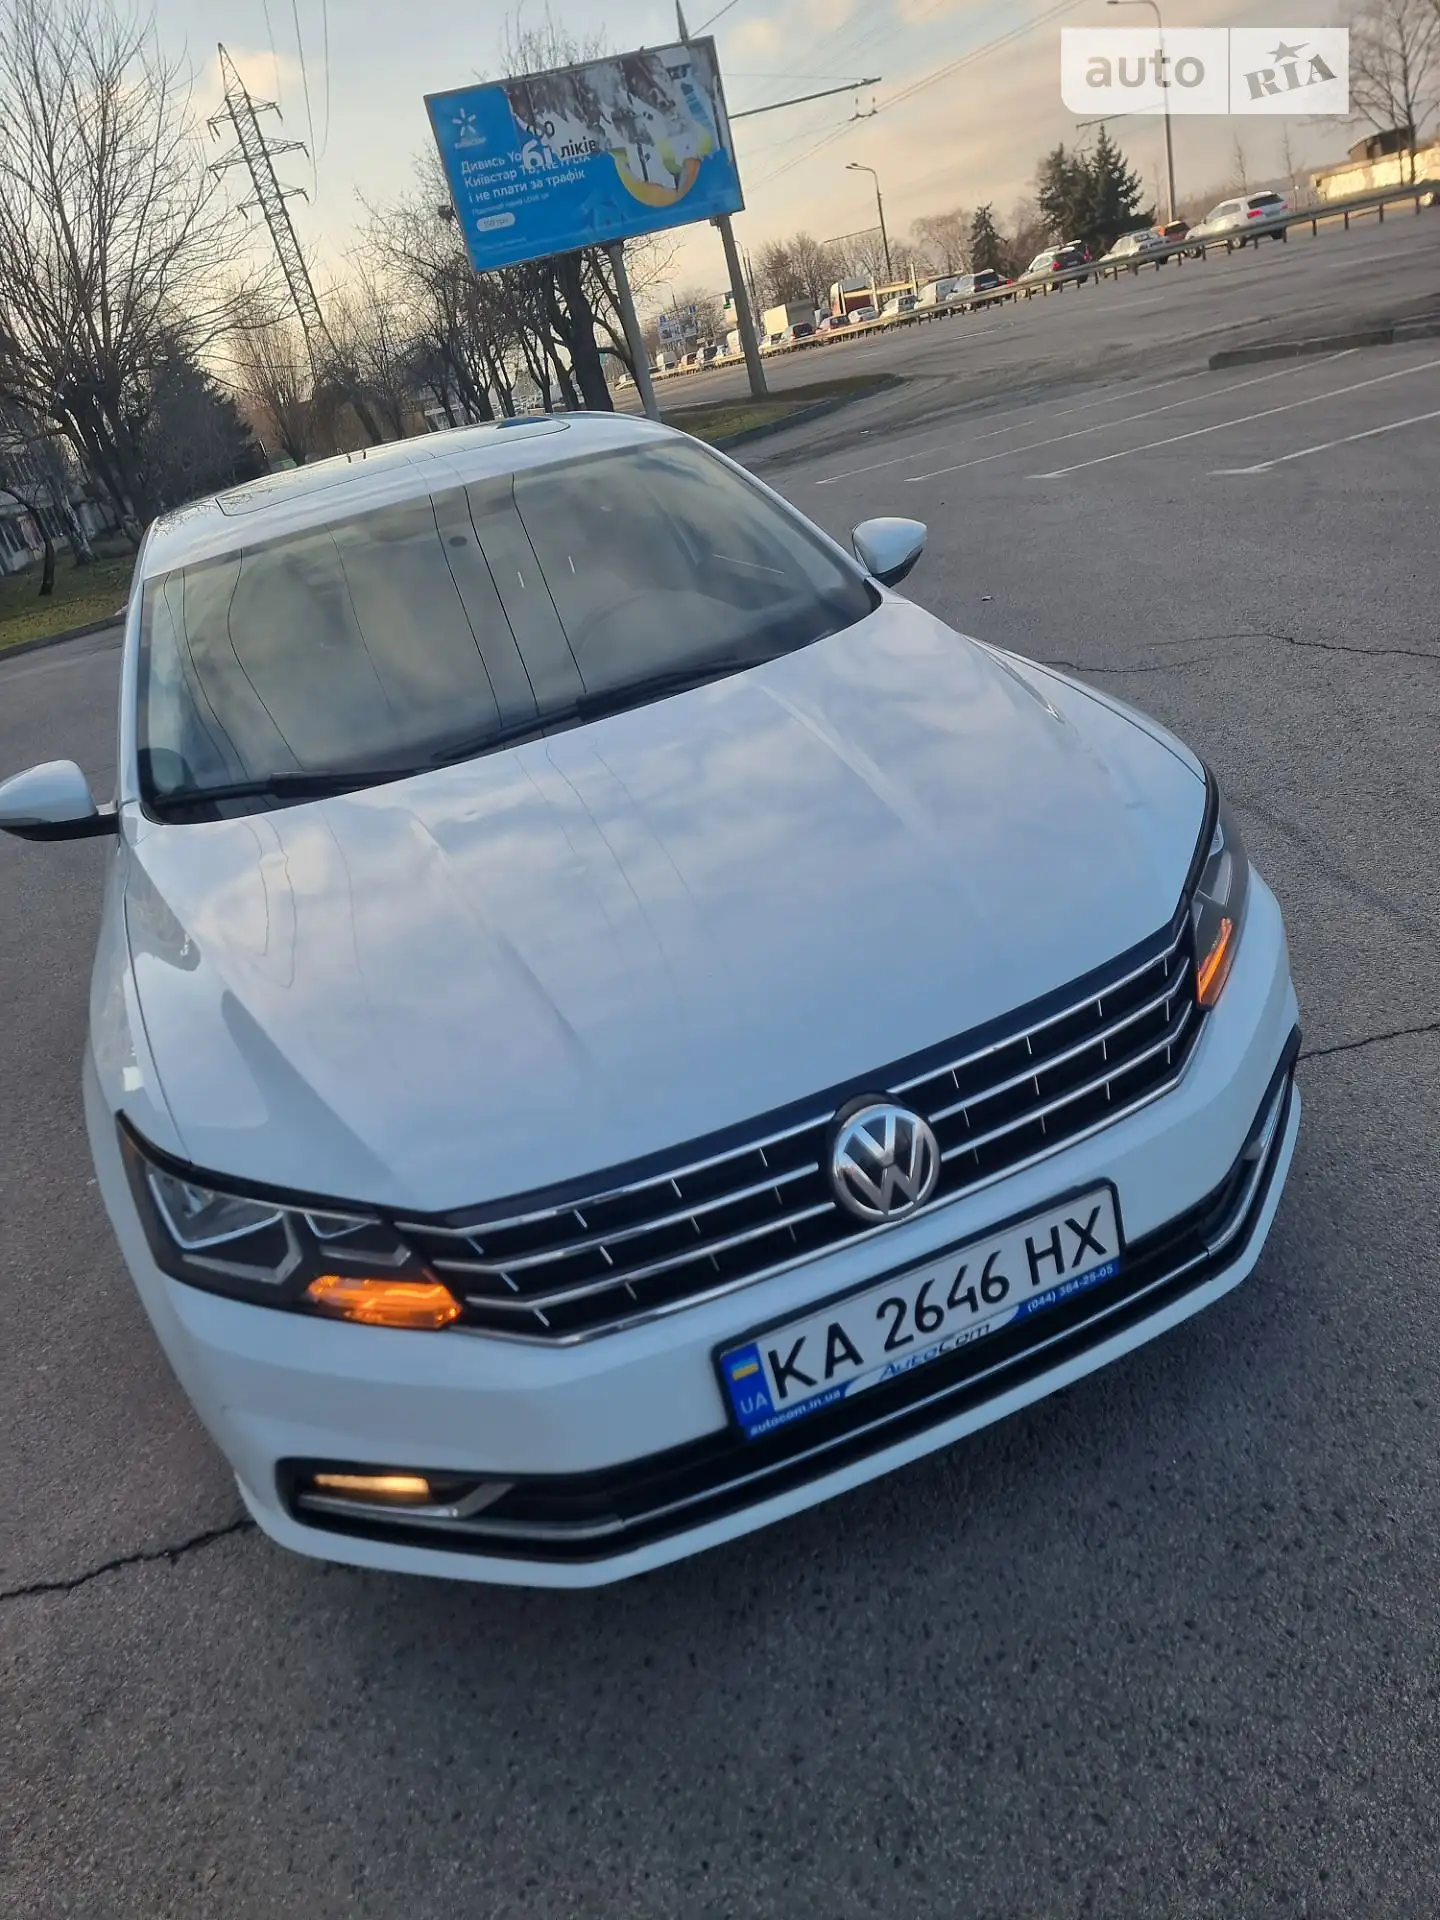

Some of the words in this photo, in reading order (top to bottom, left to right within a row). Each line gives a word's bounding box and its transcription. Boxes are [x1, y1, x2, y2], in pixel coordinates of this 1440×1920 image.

[461, 157, 505, 175] Дивись
[464, 169, 518, 189] Київстар
[476, 191, 491, 202] не
[493, 182, 528, 198] плати
[530, 179, 544, 190] за
[545, 168, 586, 188] трафік
[767, 1321, 864, 1398] KA
[876, 1250, 1011, 1353] 2646
[1025, 1205, 1108, 1286] HX
[740, 1391, 768, 1414] UA
